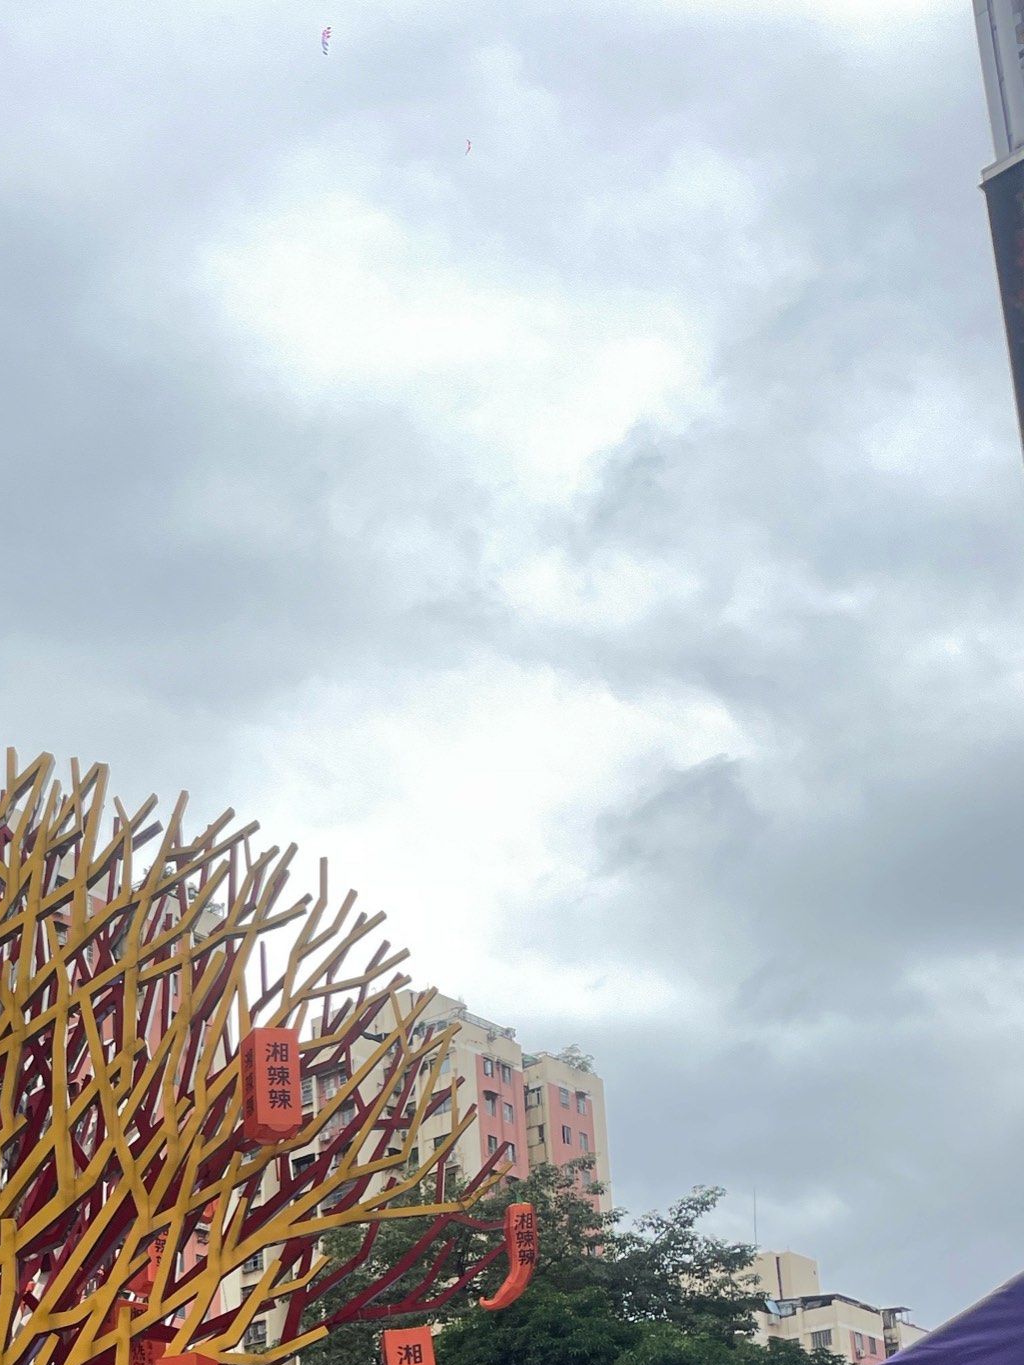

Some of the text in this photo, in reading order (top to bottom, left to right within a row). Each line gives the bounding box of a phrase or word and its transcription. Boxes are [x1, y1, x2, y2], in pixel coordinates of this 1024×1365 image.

[266, 1042, 293, 1110] 湘辣辣
[514, 1212, 535, 1267] 湘辣辣
